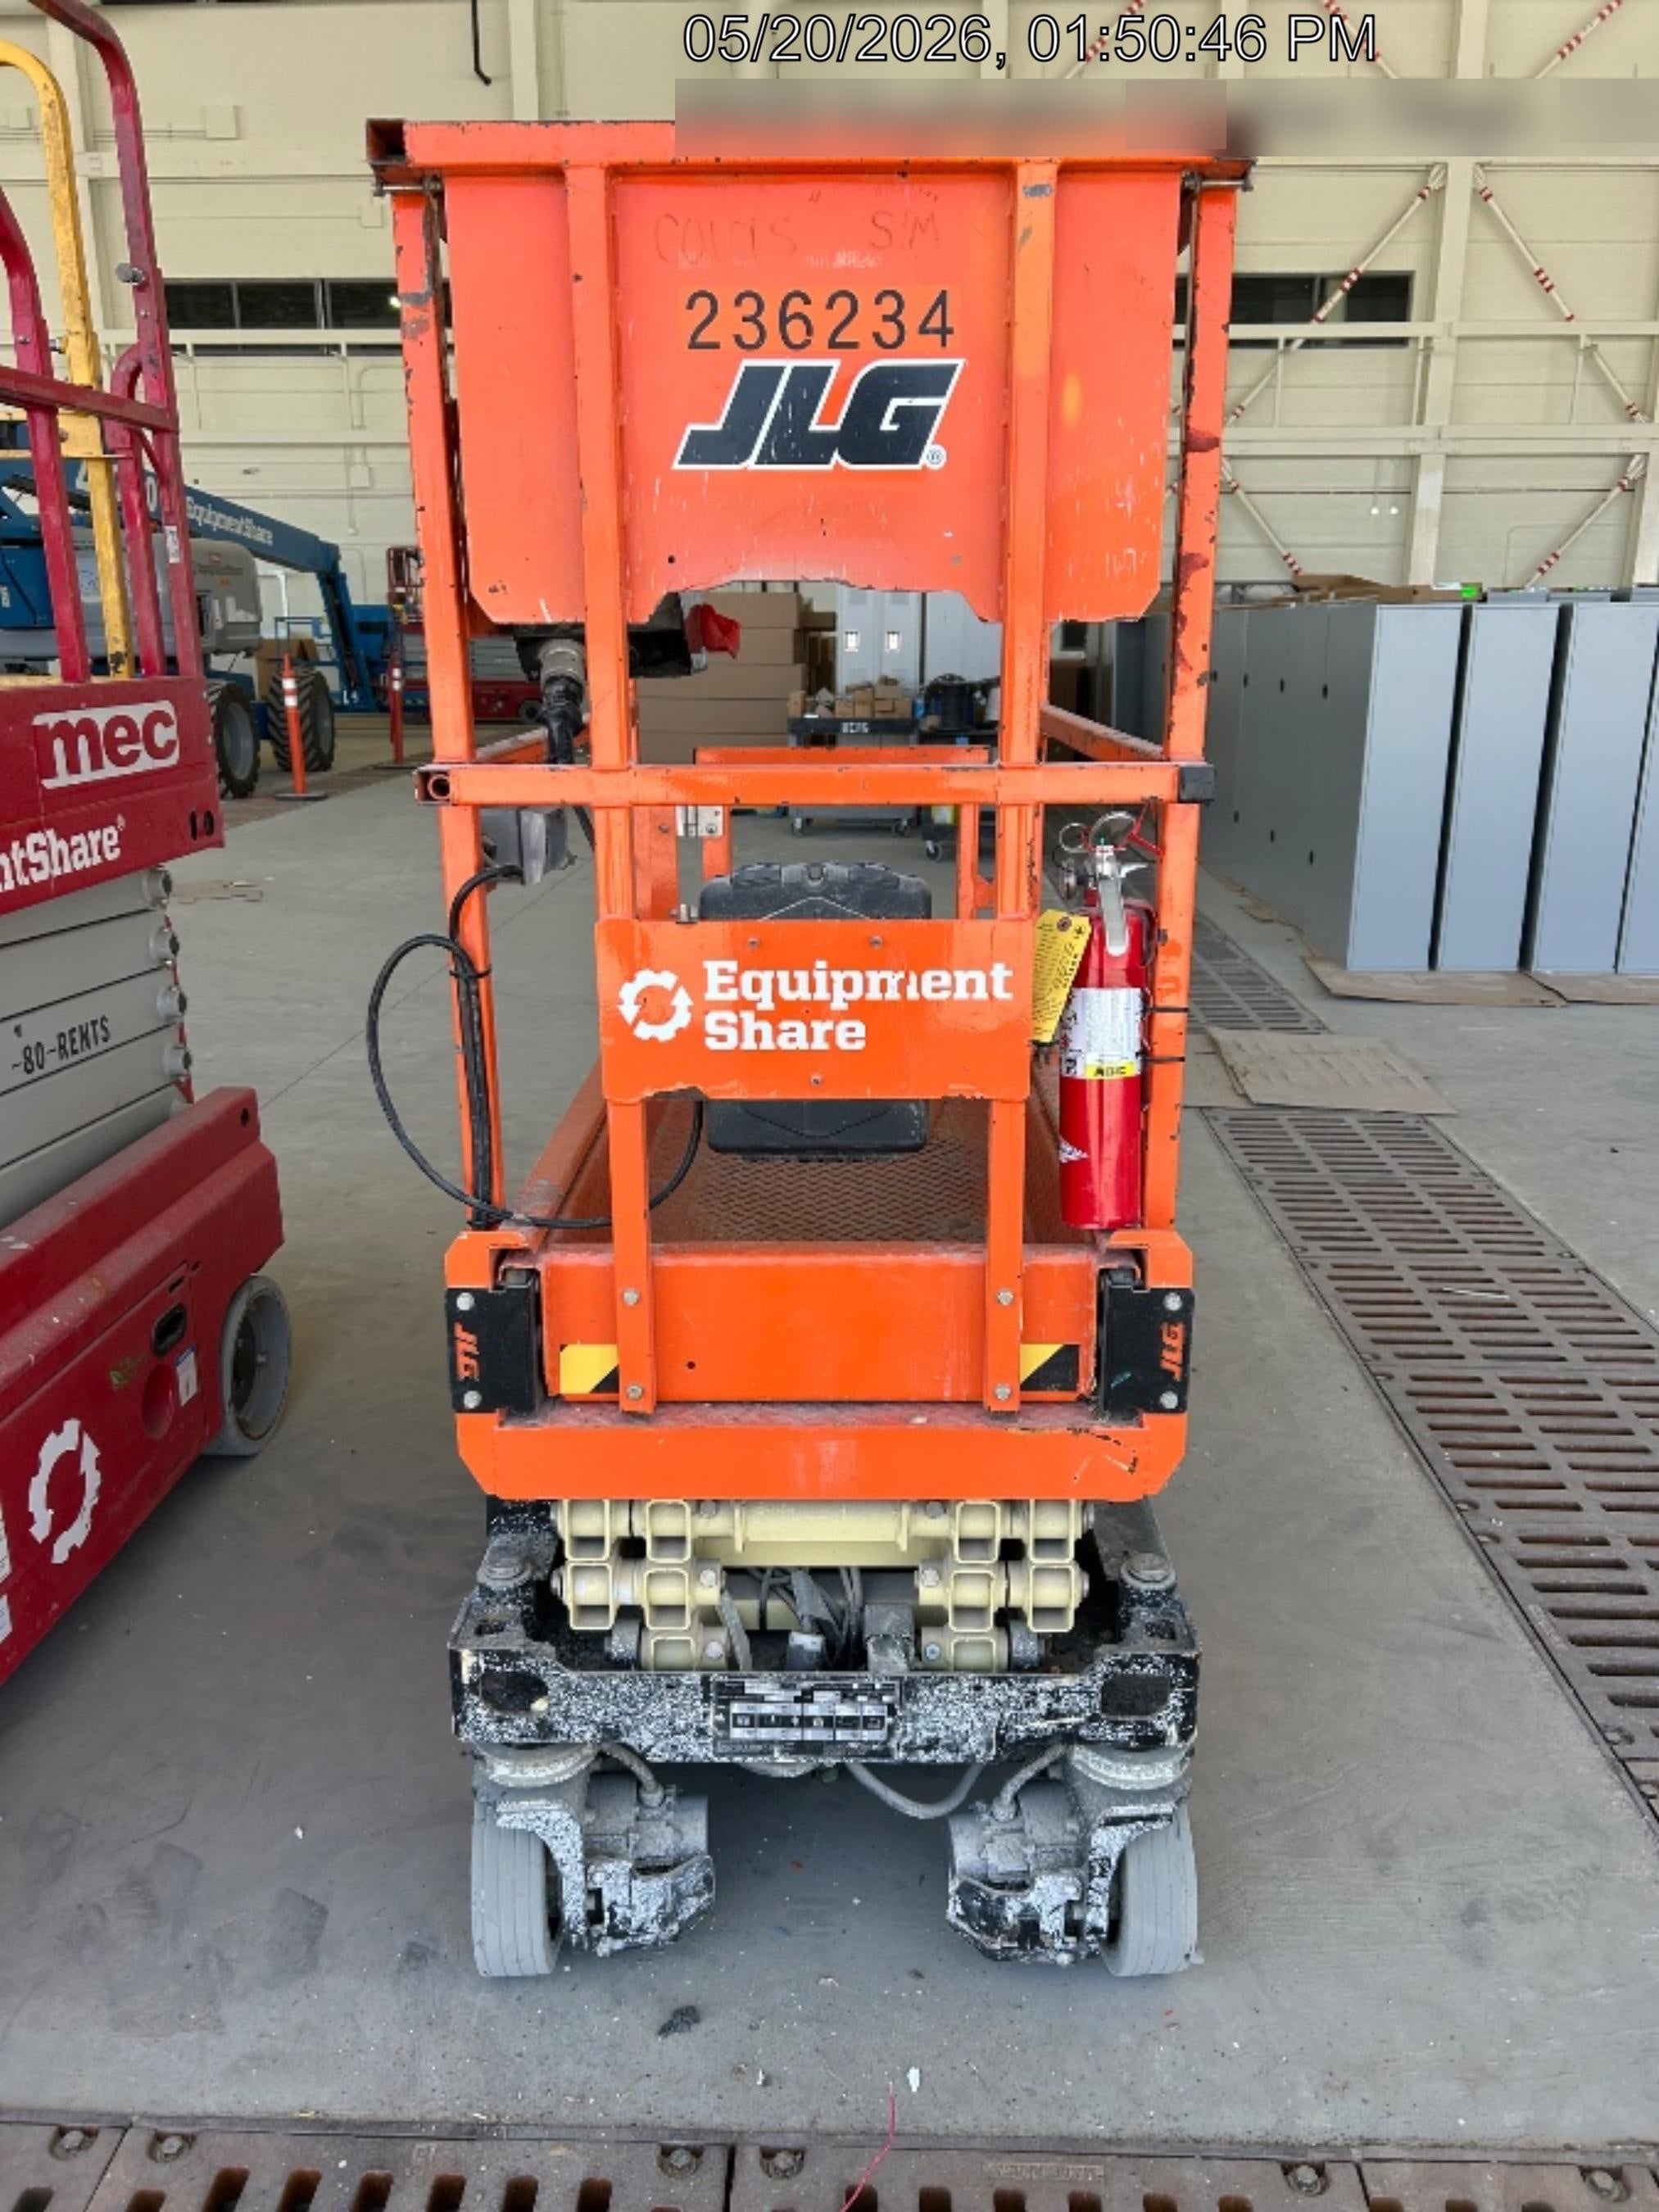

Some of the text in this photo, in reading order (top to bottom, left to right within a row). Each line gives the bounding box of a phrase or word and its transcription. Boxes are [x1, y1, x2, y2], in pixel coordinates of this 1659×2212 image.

[686, 289, 954, 351] 236234
[671, 358, 967, 470] JLG
[34, 708, 179, 781] mec
[702, 960, 1014, 1011] Equipment
[704, 1009, 867, 1051] Share
[454, 1321, 481, 1382] JLG
[1160, 1322, 1185, 1382] JLG
